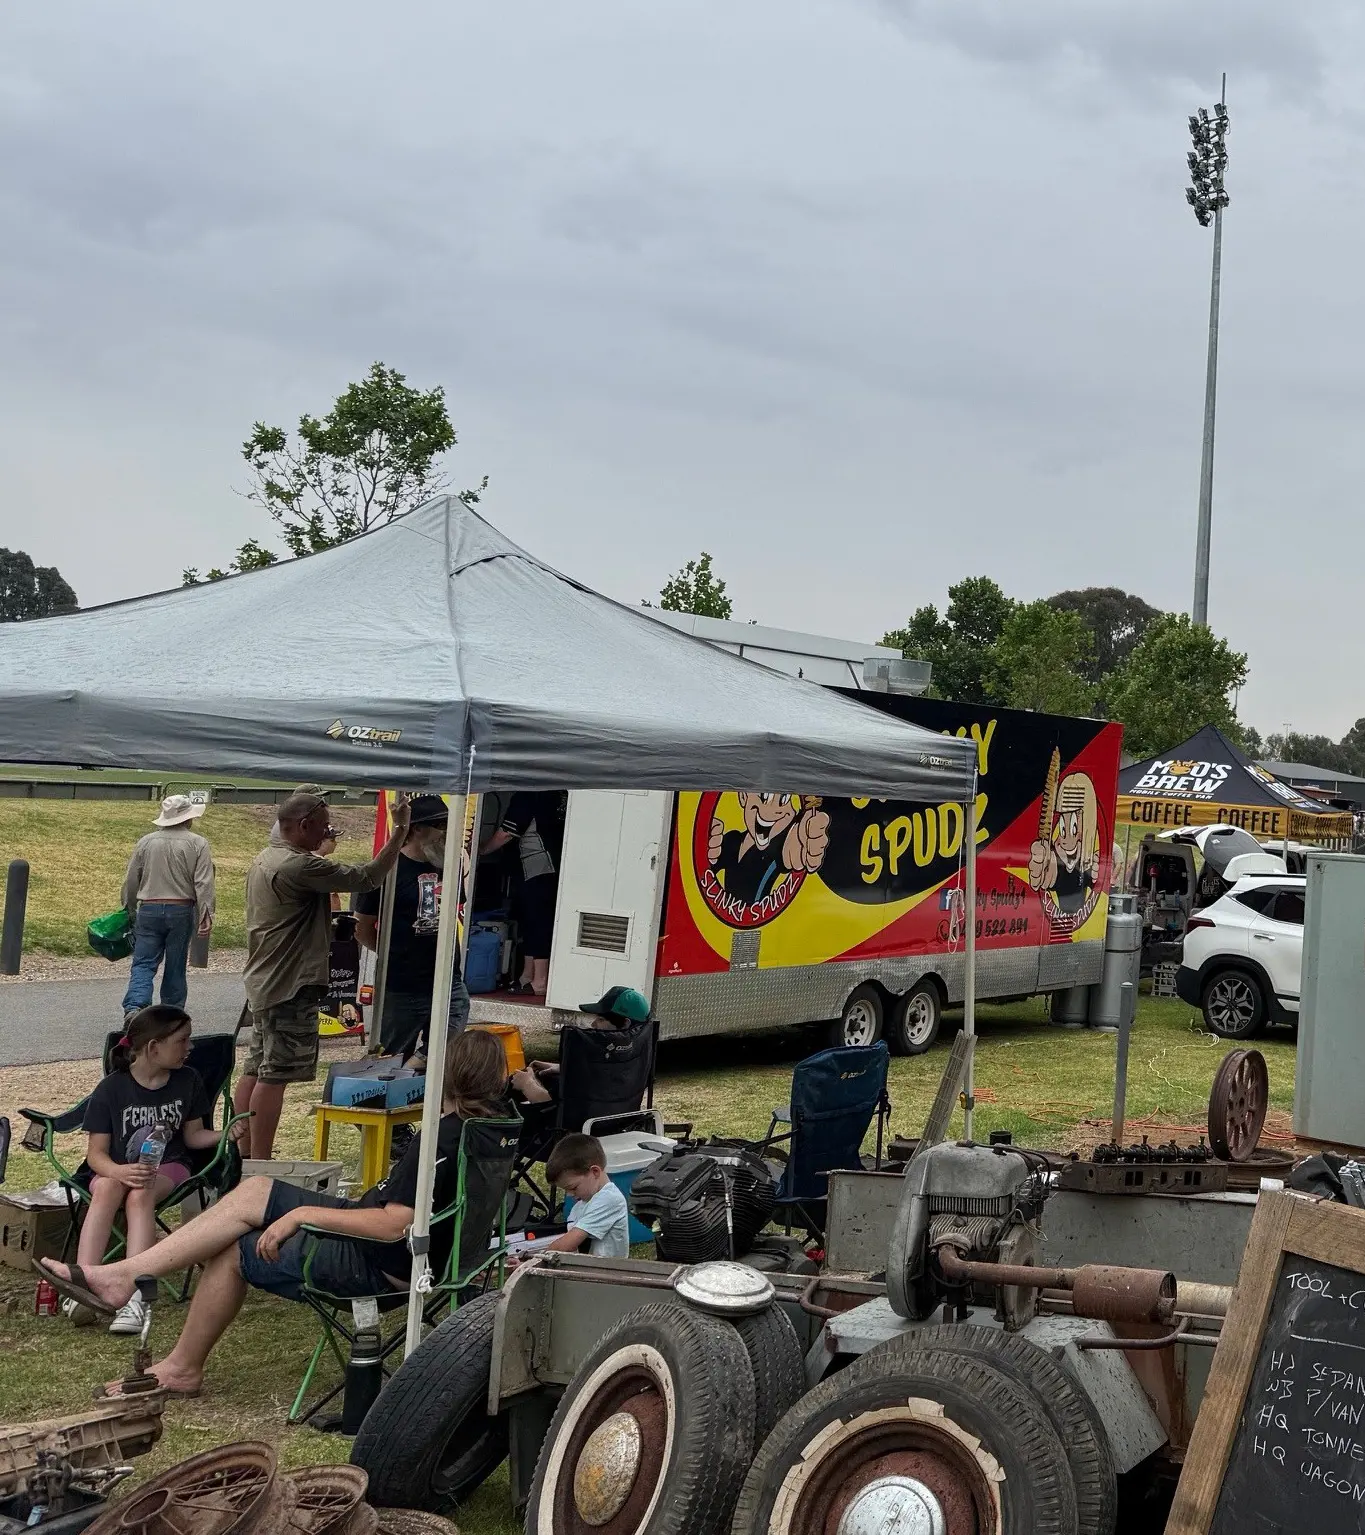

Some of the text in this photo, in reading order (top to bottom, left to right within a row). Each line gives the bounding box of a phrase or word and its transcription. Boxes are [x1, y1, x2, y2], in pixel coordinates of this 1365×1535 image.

[347, 724, 402, 743] OZtrail
[1135, 774, 1225, 793] BREW
[1162, 791, 1194, 799] COFFEE
[1130, 800, 1281, 835] COFFEE COFFEE
[700, 869, 800, 922] SLINKY SPUDZ
[984, 919, 1007, 938] 522
[121, 1099, 183, 1138] FEARLESS
[1286, 1273, 1333, 1299] TOOL
[1265, 1378, 1365, 1425] WB P/VAN
[1258, 1404, 1290, 1434] HQ
[1253, 1435, 1285, 1467] HQ
